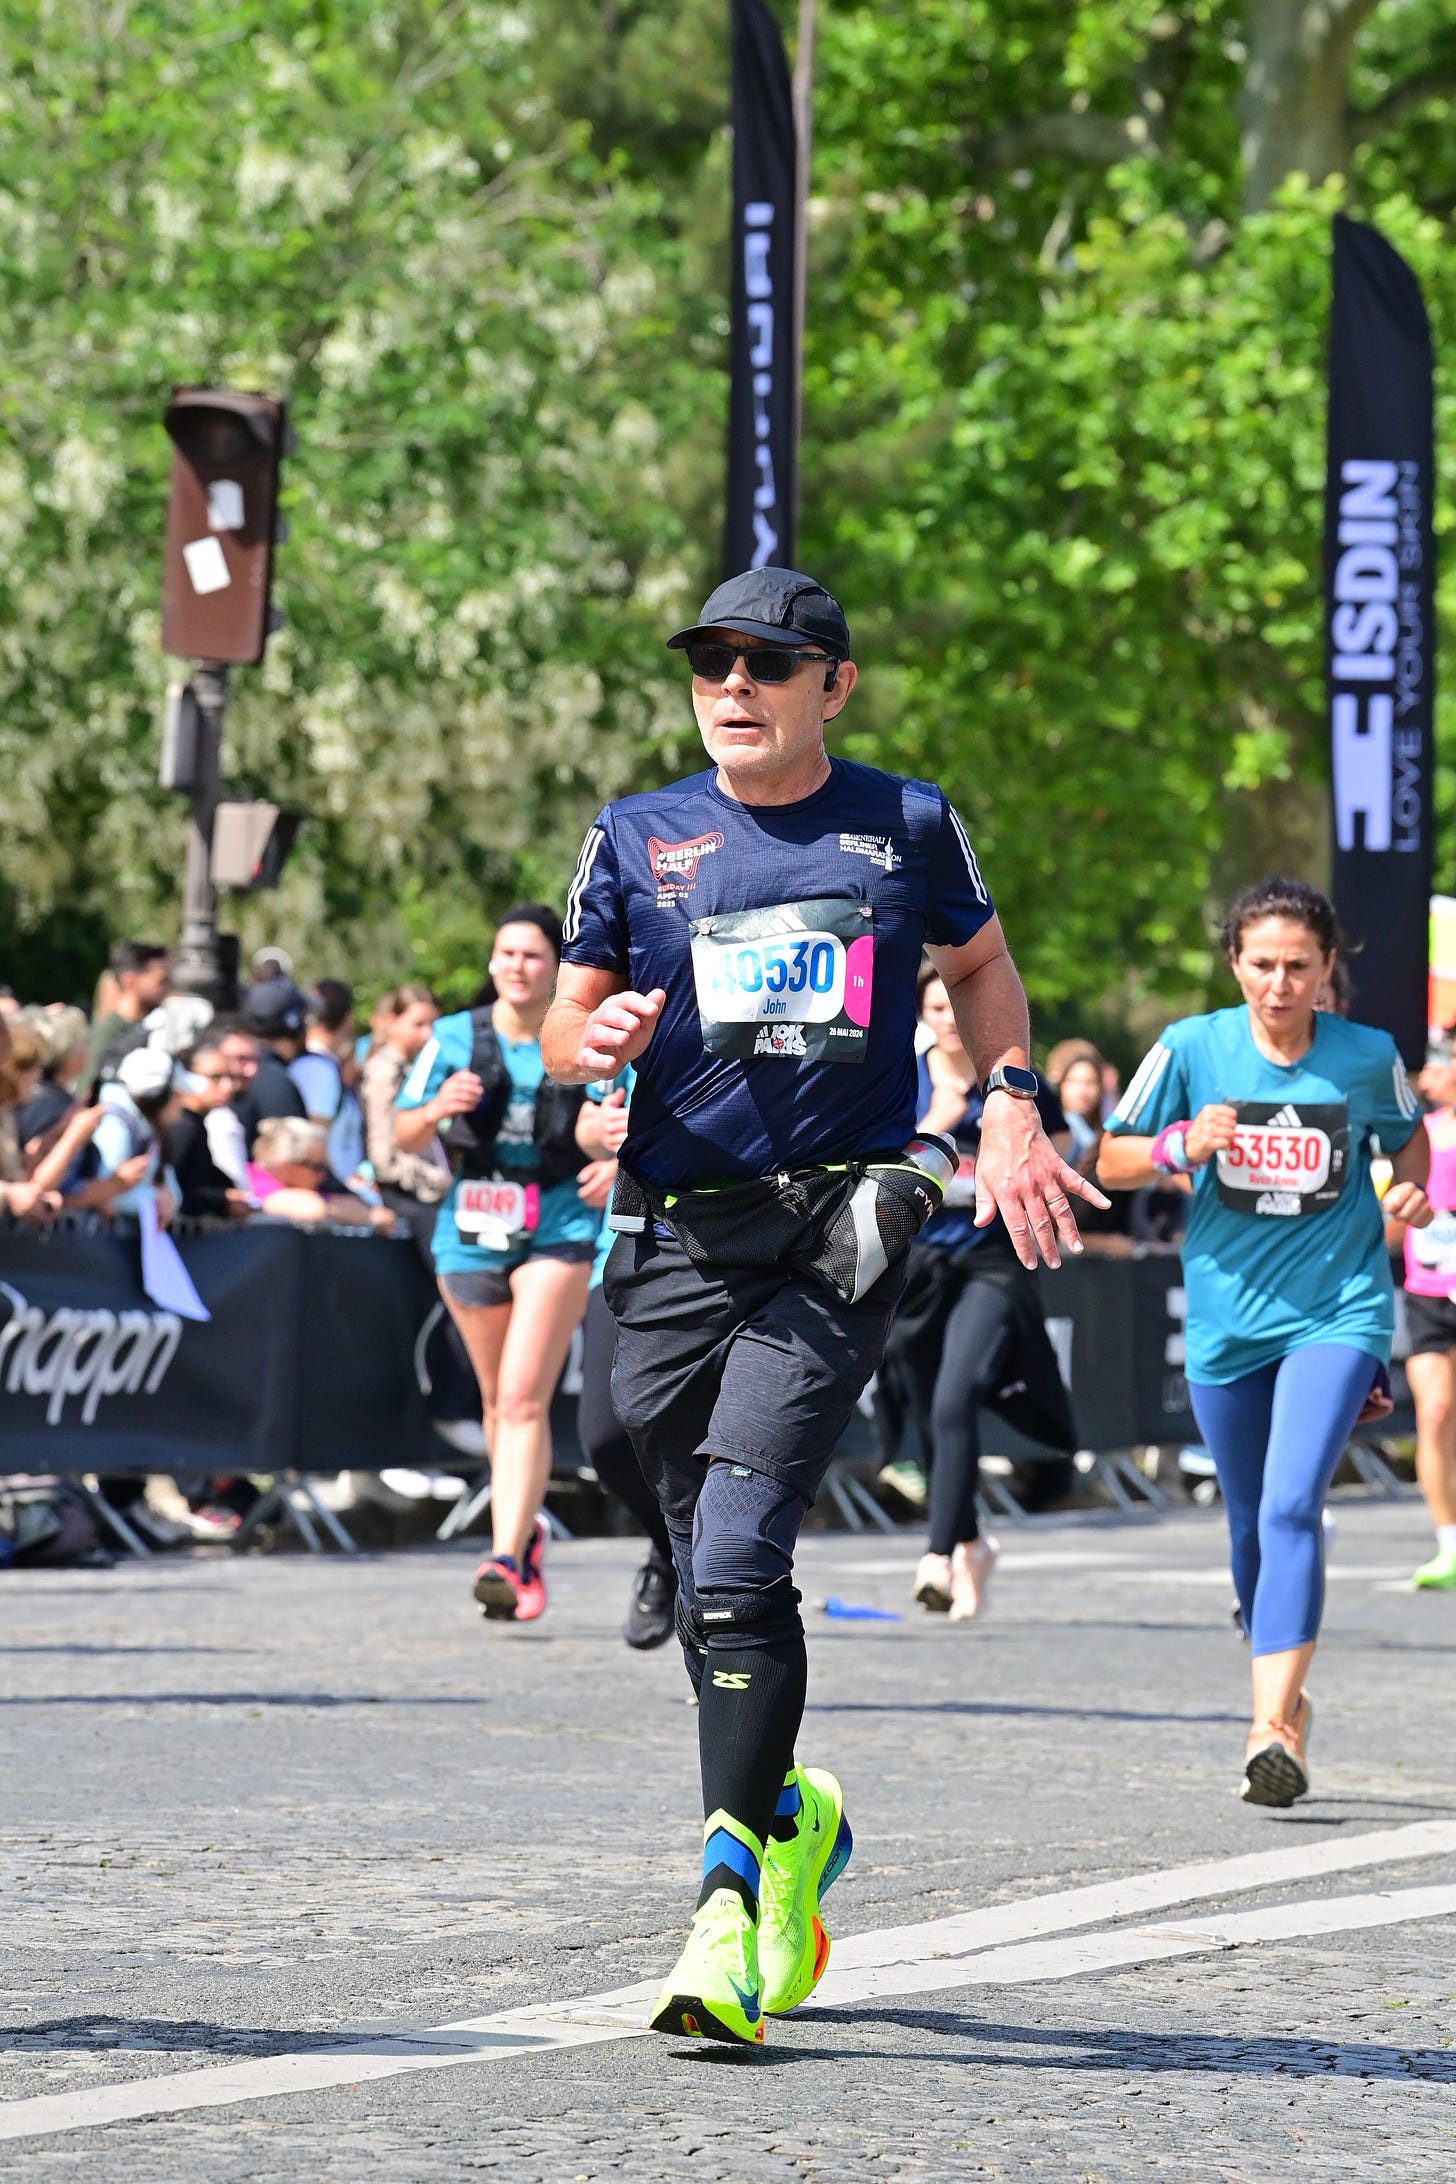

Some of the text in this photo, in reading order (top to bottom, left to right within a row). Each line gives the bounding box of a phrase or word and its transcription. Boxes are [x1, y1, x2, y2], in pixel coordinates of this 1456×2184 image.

[1331, 460, 1399, 681] ISDIN
[1393, 460, 1424, 852] LOVE YOUR SKIN
[840, 840, 878, 851] BERLINER
[850, 834, 886, 845] GENERALI
[657, 842, 716, 862] #BERLIN
[655, 859, 694, 872] HALF
[870, 856, 886, 867] 2023
[656, 900, 676, 908] 2023
[712, 941, 835, 994] 40530
[853, 975, 864, 987] 1h
[763, 999, 787, 1015] John
[829, 1027, 863, 1039] 26 MAI 2024
[753, 1036, 807, 1056] PARIS
[1228, 1132, 1322, 1172] 53530
